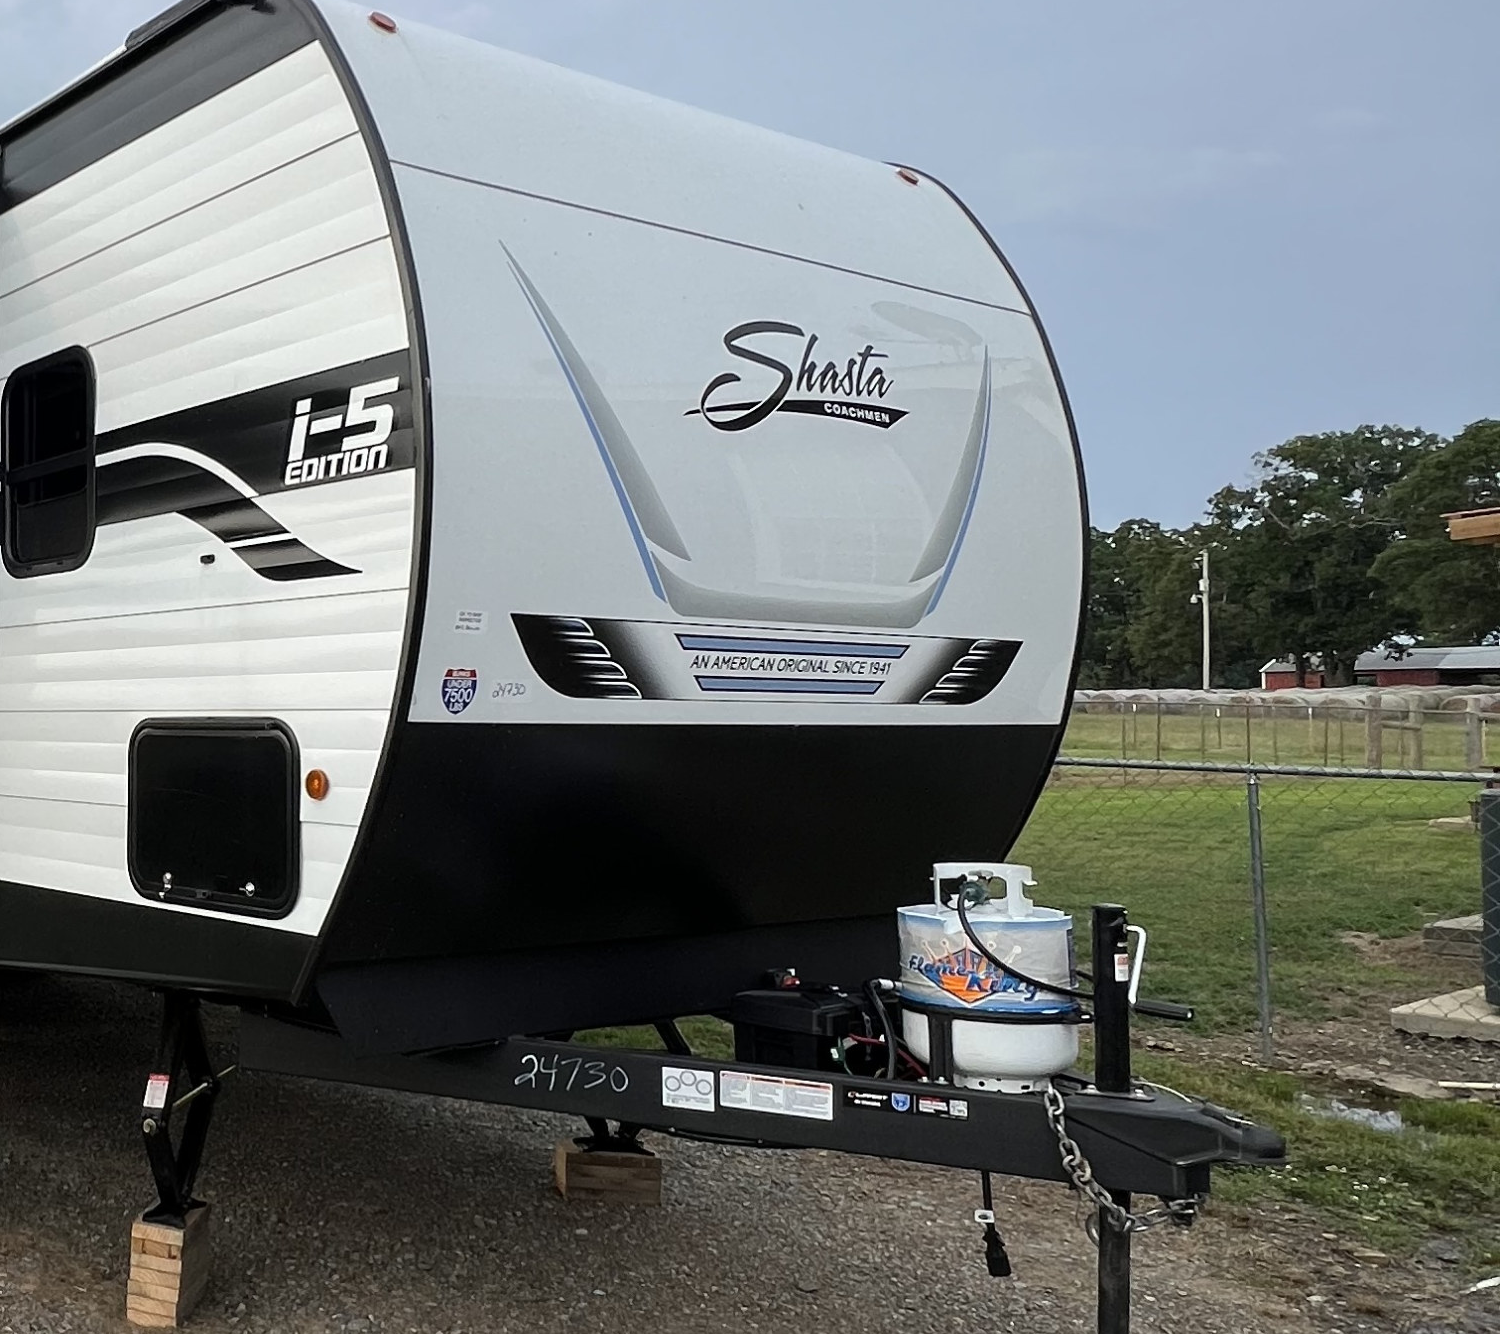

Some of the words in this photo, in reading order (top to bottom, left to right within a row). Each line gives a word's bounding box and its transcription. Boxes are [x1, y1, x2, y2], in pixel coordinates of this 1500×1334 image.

[701, 321, 895, 432] Shasta
[287, 376, 400, 463] i-5
[823, 402, 891, 424] COACHMEN
[284, 443, 389, 486] EDITION
[690, 654, 711, 669] AN
[711, 655, 777, 672] AMERICAN
[777, 658, 830, 674] ORIGINAL
[832, 660, 867, 675] SINCE
[868, 661, 892, 675] 1941
[444, 688, 473, 703] 7500
[492, 682, 527, 699] 24730
[908, 954, 970, 976] Flame
[514, 1053, 629, 1093] 24730
